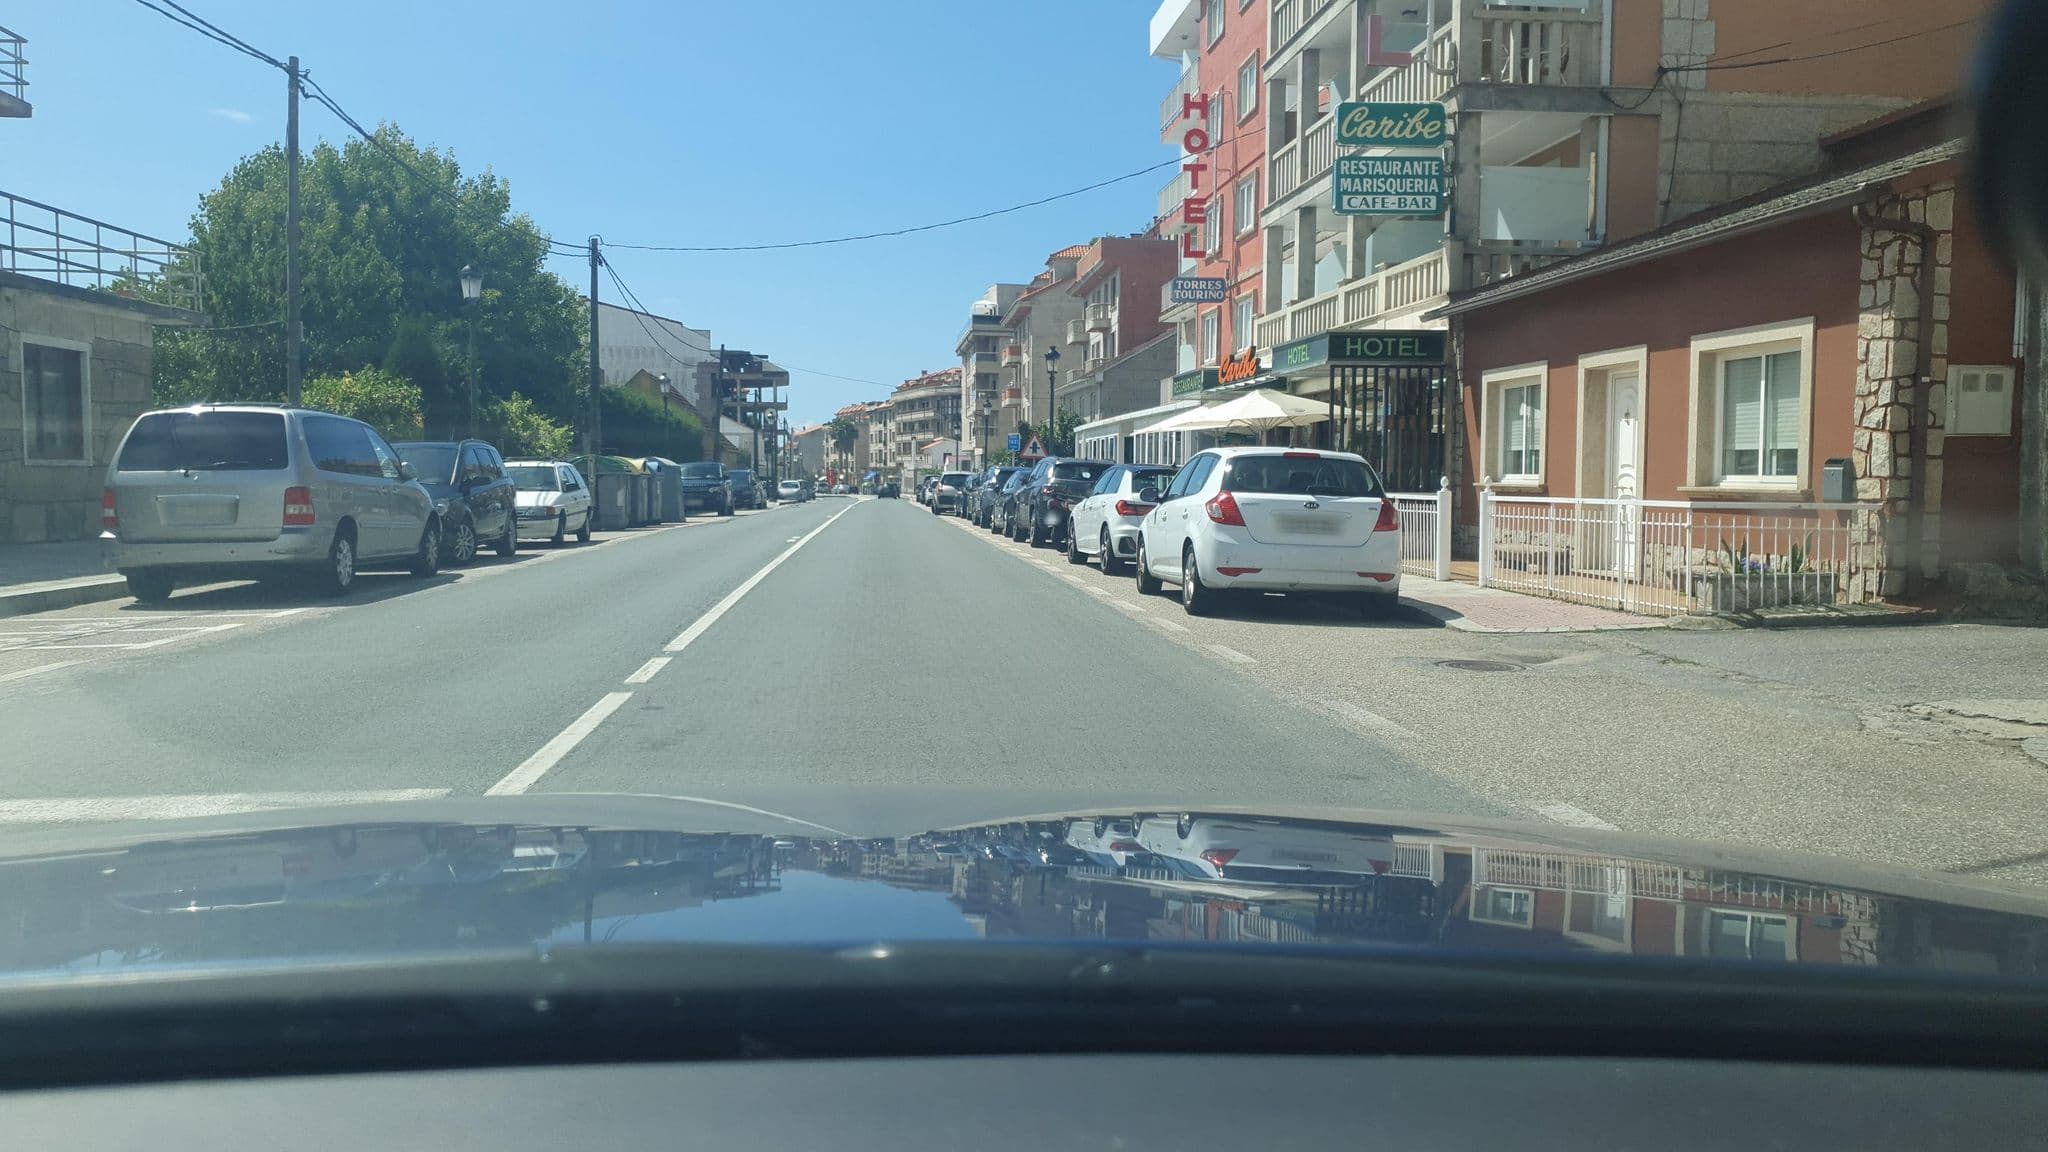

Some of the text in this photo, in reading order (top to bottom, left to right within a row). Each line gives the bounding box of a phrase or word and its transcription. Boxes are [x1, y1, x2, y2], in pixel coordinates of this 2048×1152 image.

[1341, 106, 1442, 139] Caribe
[1183, 93, 1208, 258] HOTEL
[1340, 160, 1440, 175] RESTAURANTE
[1340, 178, 1439, 194] MARISQUERIA
[1346, 197, 1432, 208] CAFE-BAR
[1175, 280, 1222, 290] TORRES
[1287, 344, 1310, 366] HOTEL
[1347, 337, 1427, 357] HOTEL
[1218, 346, 1257, 385] Caribe
